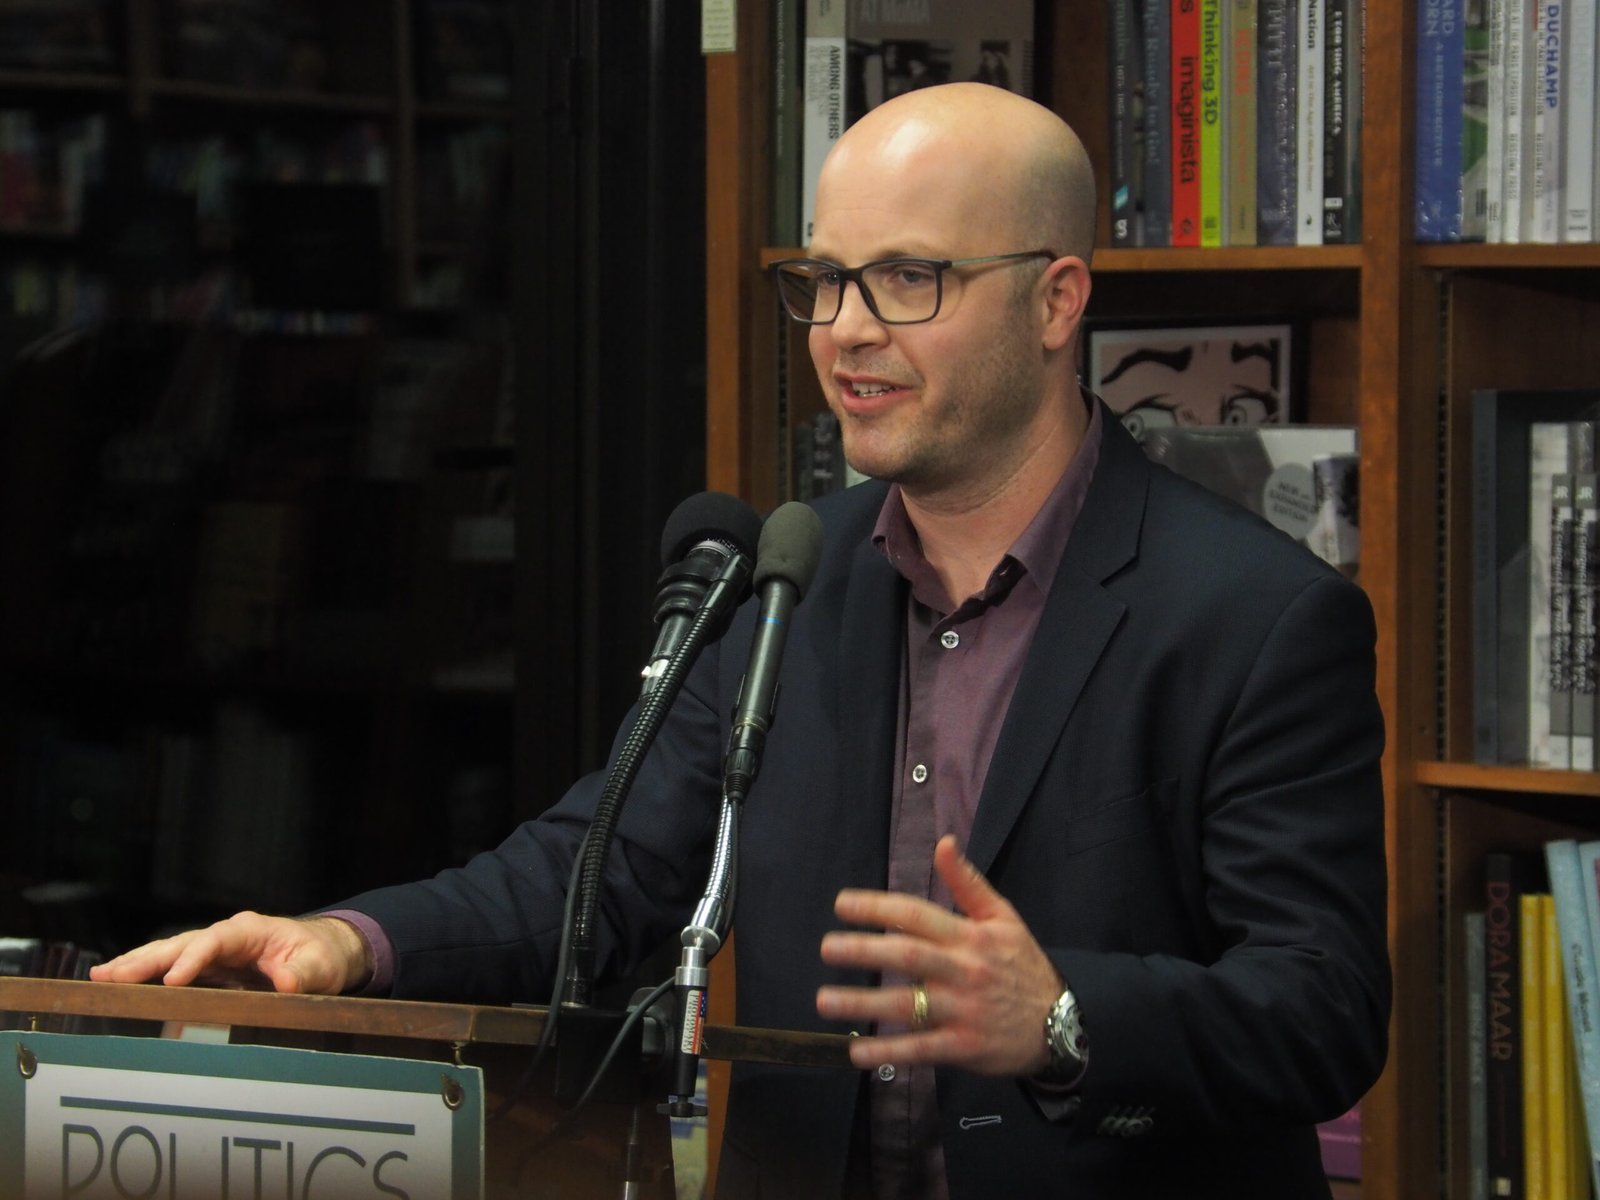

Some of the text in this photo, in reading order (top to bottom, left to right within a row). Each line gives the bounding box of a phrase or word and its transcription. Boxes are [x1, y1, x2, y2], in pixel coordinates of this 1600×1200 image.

[1202, 0, 1219, 125] Thinking 3D
[1308, 0, 1319, 49] Nation
[1545, 5, 1560, 109] DUCHAMP
[828, 45, 841, 140] AMONG OTHERS
[1177, 56, 1198, 184] imaginista
[1487, 880, 1511, 966] DORA
[1490, 971, 1512, 1061] MAAR
[61, 1123, 409, 1200] POLITICS
